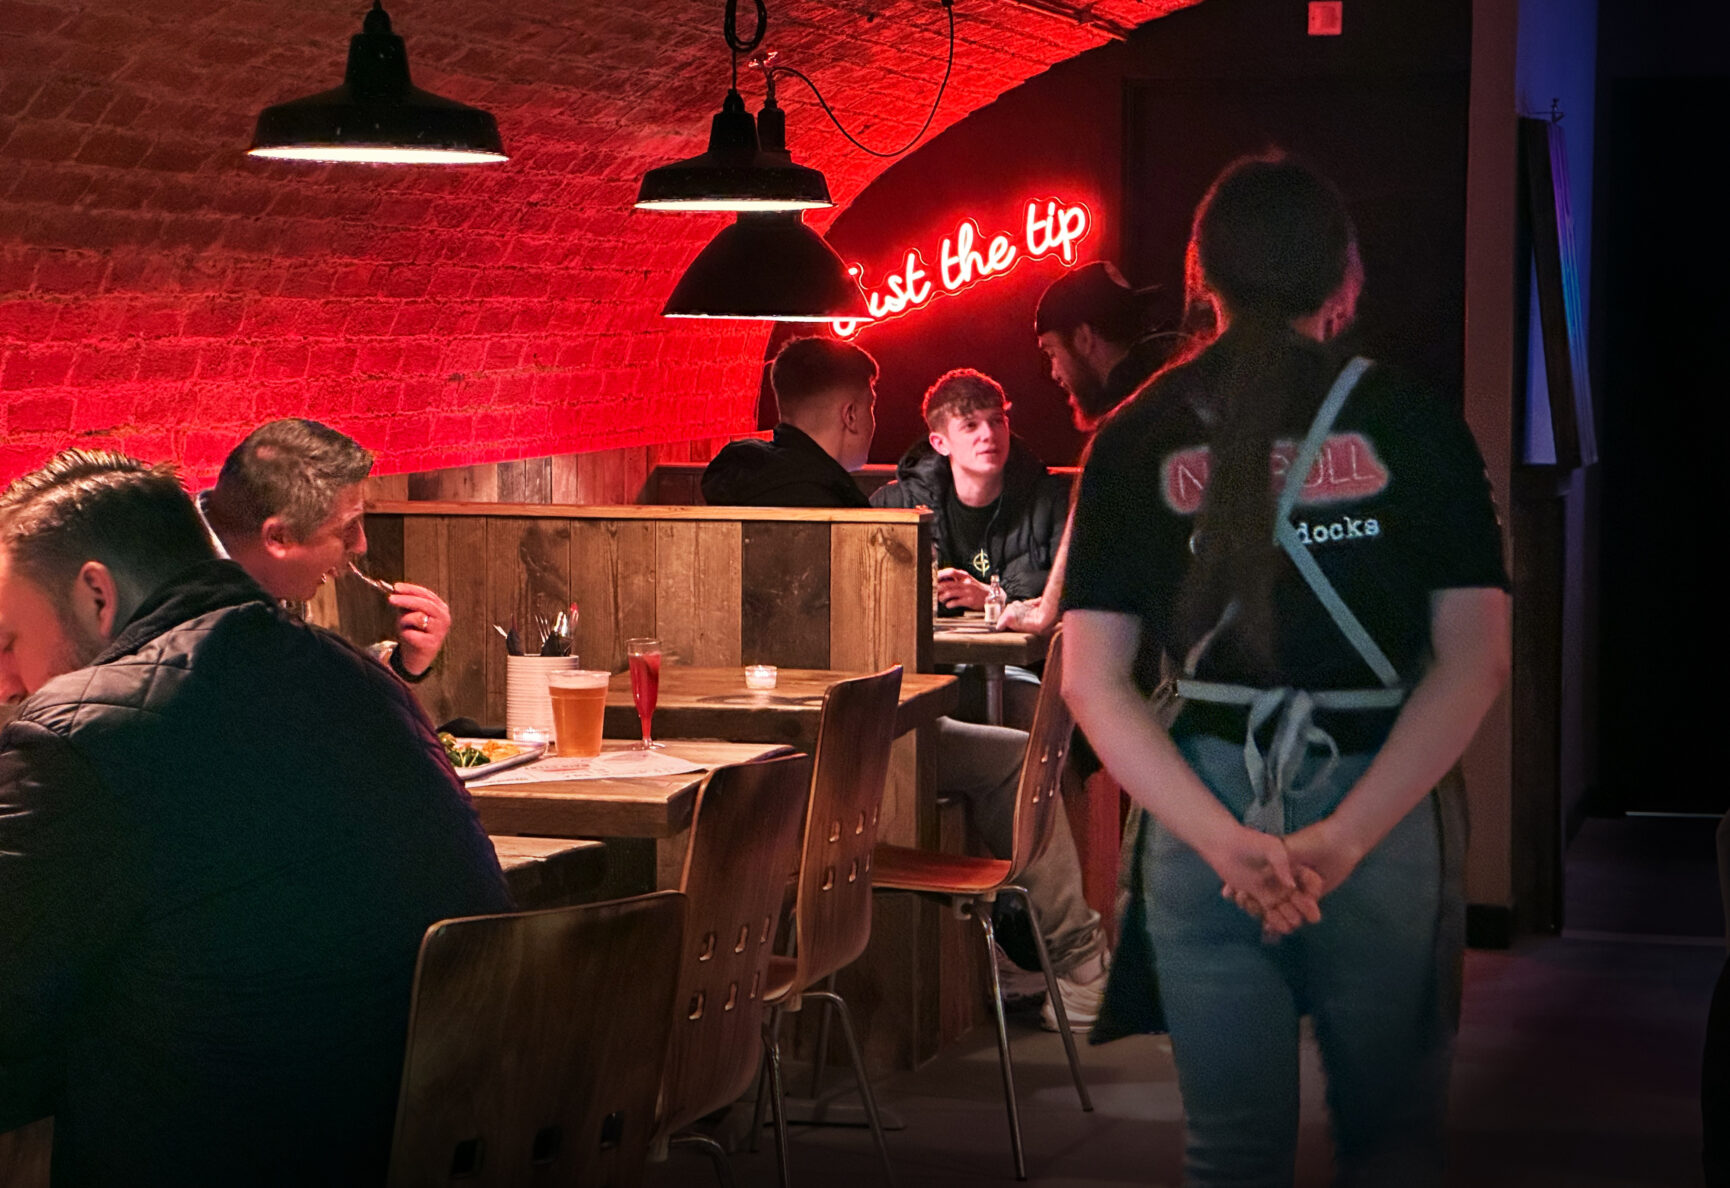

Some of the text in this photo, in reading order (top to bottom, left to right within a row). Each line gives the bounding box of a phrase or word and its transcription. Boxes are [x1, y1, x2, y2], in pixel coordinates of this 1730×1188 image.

[940, 222, 1017, 291] the
[1026, 202, 1086, 261] tip
[1296, 515, 1381, 546] docks
